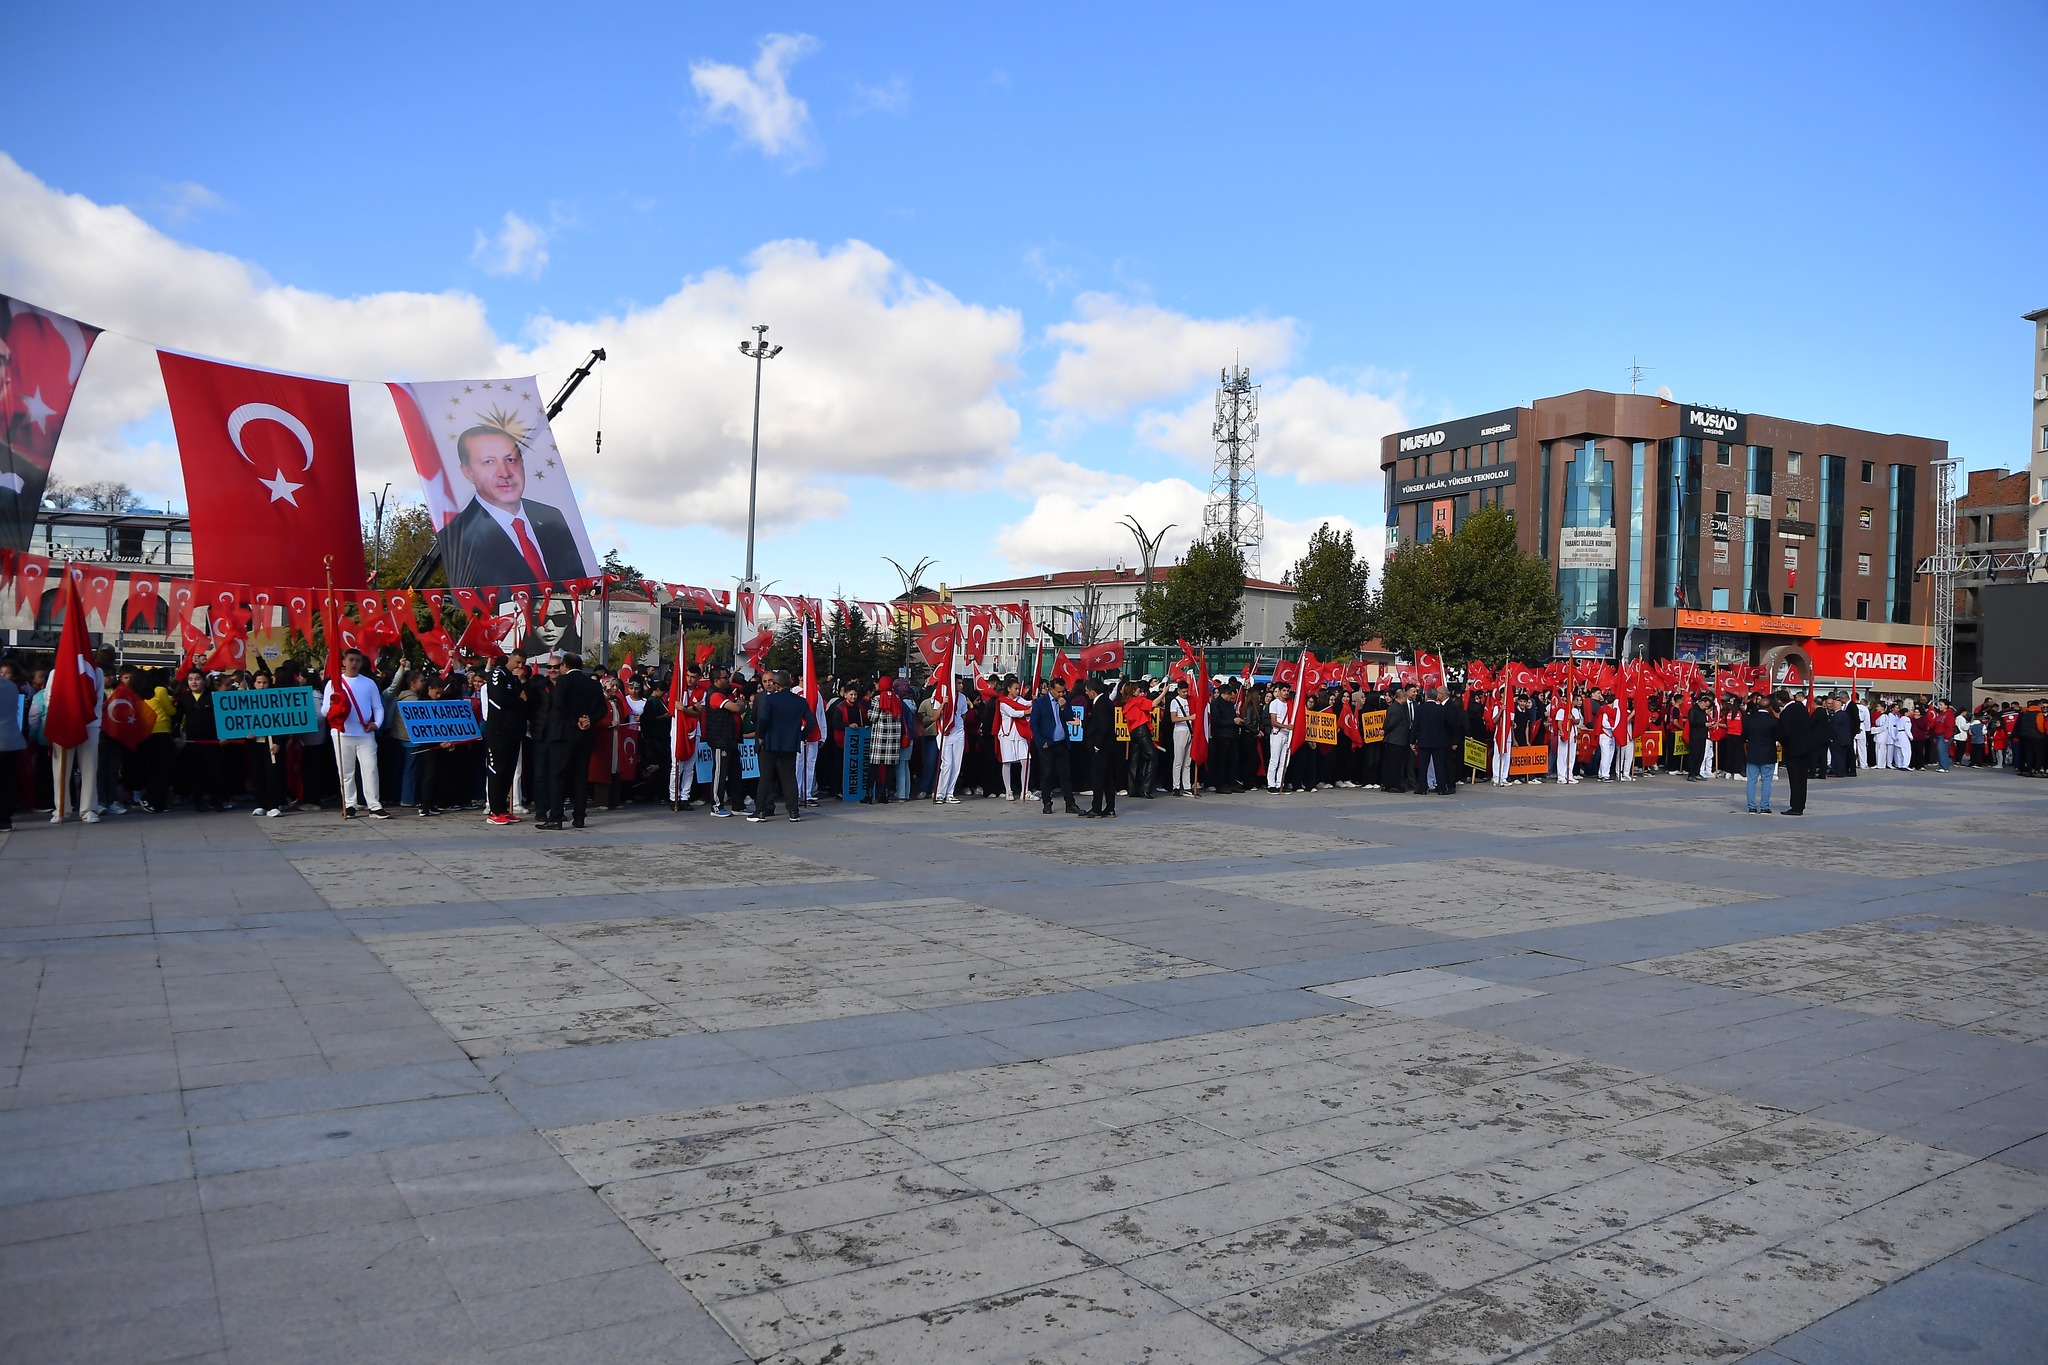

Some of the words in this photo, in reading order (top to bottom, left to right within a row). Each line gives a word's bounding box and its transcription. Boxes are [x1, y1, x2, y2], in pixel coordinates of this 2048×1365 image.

[1480, 423, 1512, 436] KIRŞEHİR
[1402, 483, 1425, 494] YÜKSEK
[1448, 475, 1473, 487] YÜKSEK
[1684, 614, 1735, 627] HOTEL
[1844, 651, 1907, 670] SCHAFER
[220, 690, 308, 711] CUMHURİYET
[225, 711, 308, 731] ORTAOKULU
[402, 705, 431, 720] SIRRI
[431, 704, 472, 720] KARDEŞ
[411, 723, 477, 738] ORTAOKULU
[849, 757, 858, 795] MERKEZ
